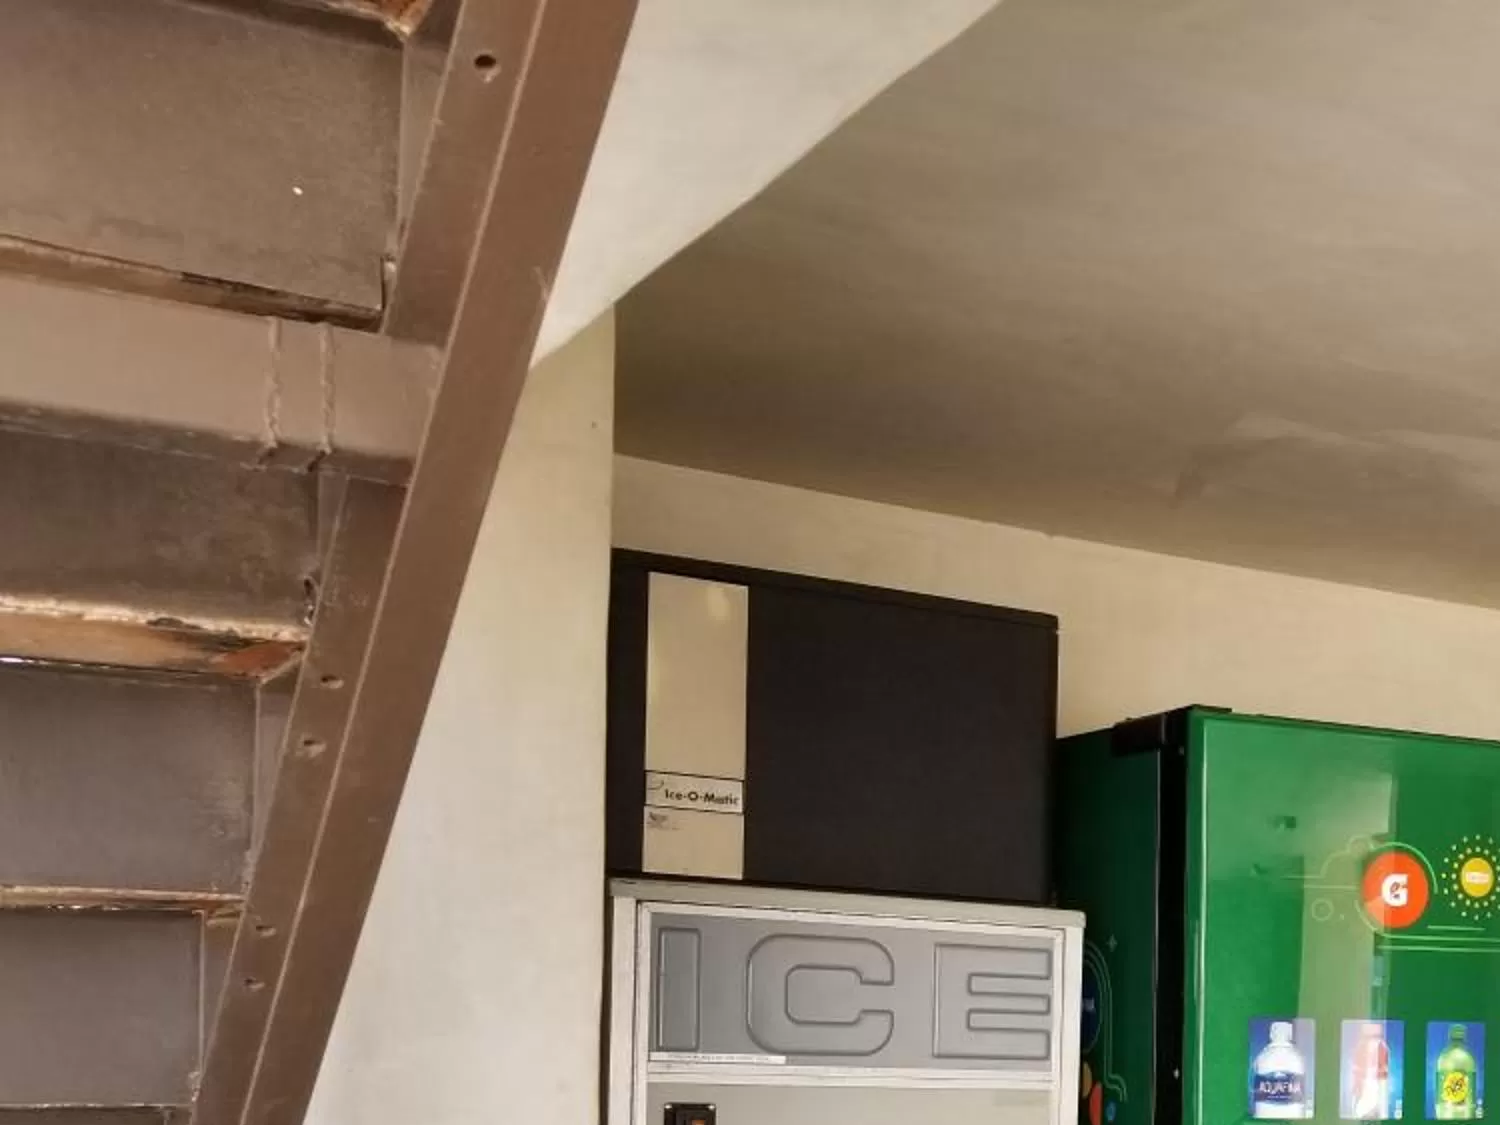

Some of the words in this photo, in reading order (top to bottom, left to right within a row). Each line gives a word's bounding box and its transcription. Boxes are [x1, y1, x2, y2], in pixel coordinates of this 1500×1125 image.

[664, 788, 740, 805] Ice-O-Matic
[1381, 873, 1409, 907] G
[656, 926, 1052, 1060] ICE
